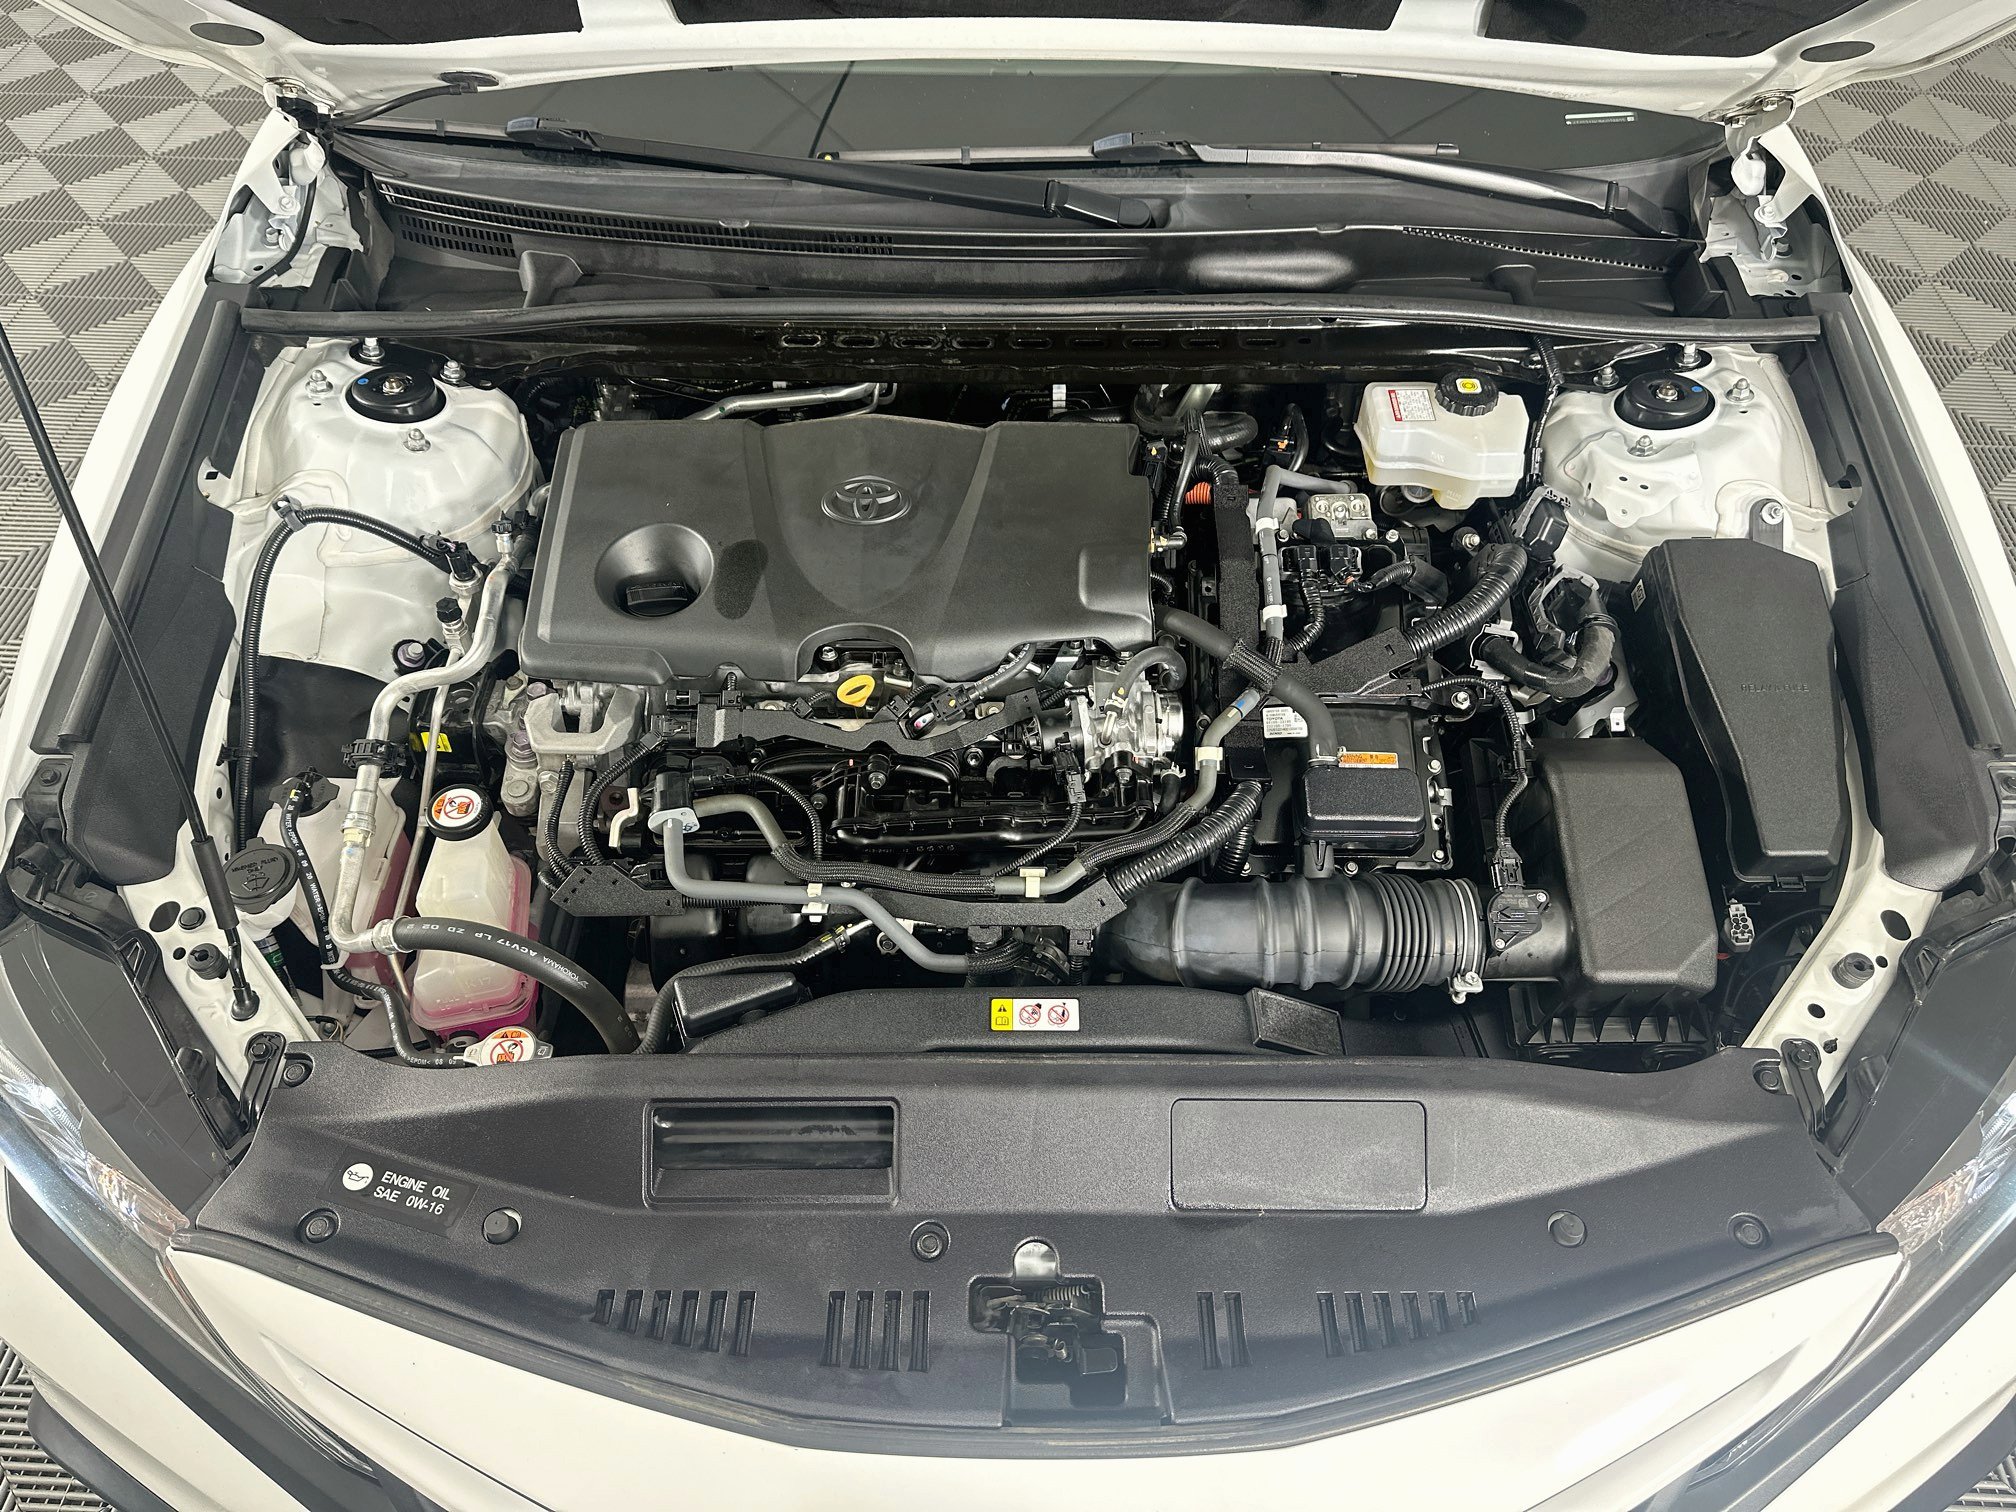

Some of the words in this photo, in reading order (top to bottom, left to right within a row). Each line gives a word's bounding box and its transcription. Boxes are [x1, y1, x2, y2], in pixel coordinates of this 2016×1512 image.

[305, 872, 313, 880] 20
[309, 882, 321, 904] WATER
[447, 926, 465, 934] ZD
[474, 931, 492, 941] LP
[497, 938, 538, 957] ACV17
[543, 956, 580, 983] YOKOHAMA
[381, 1170, 428, 1193] ENGINE
[431, 1185, 450, 1200] OIL
[373, 1185, 401, 1203] SAE
[405, 1194, 445, 1215] 0W-16
